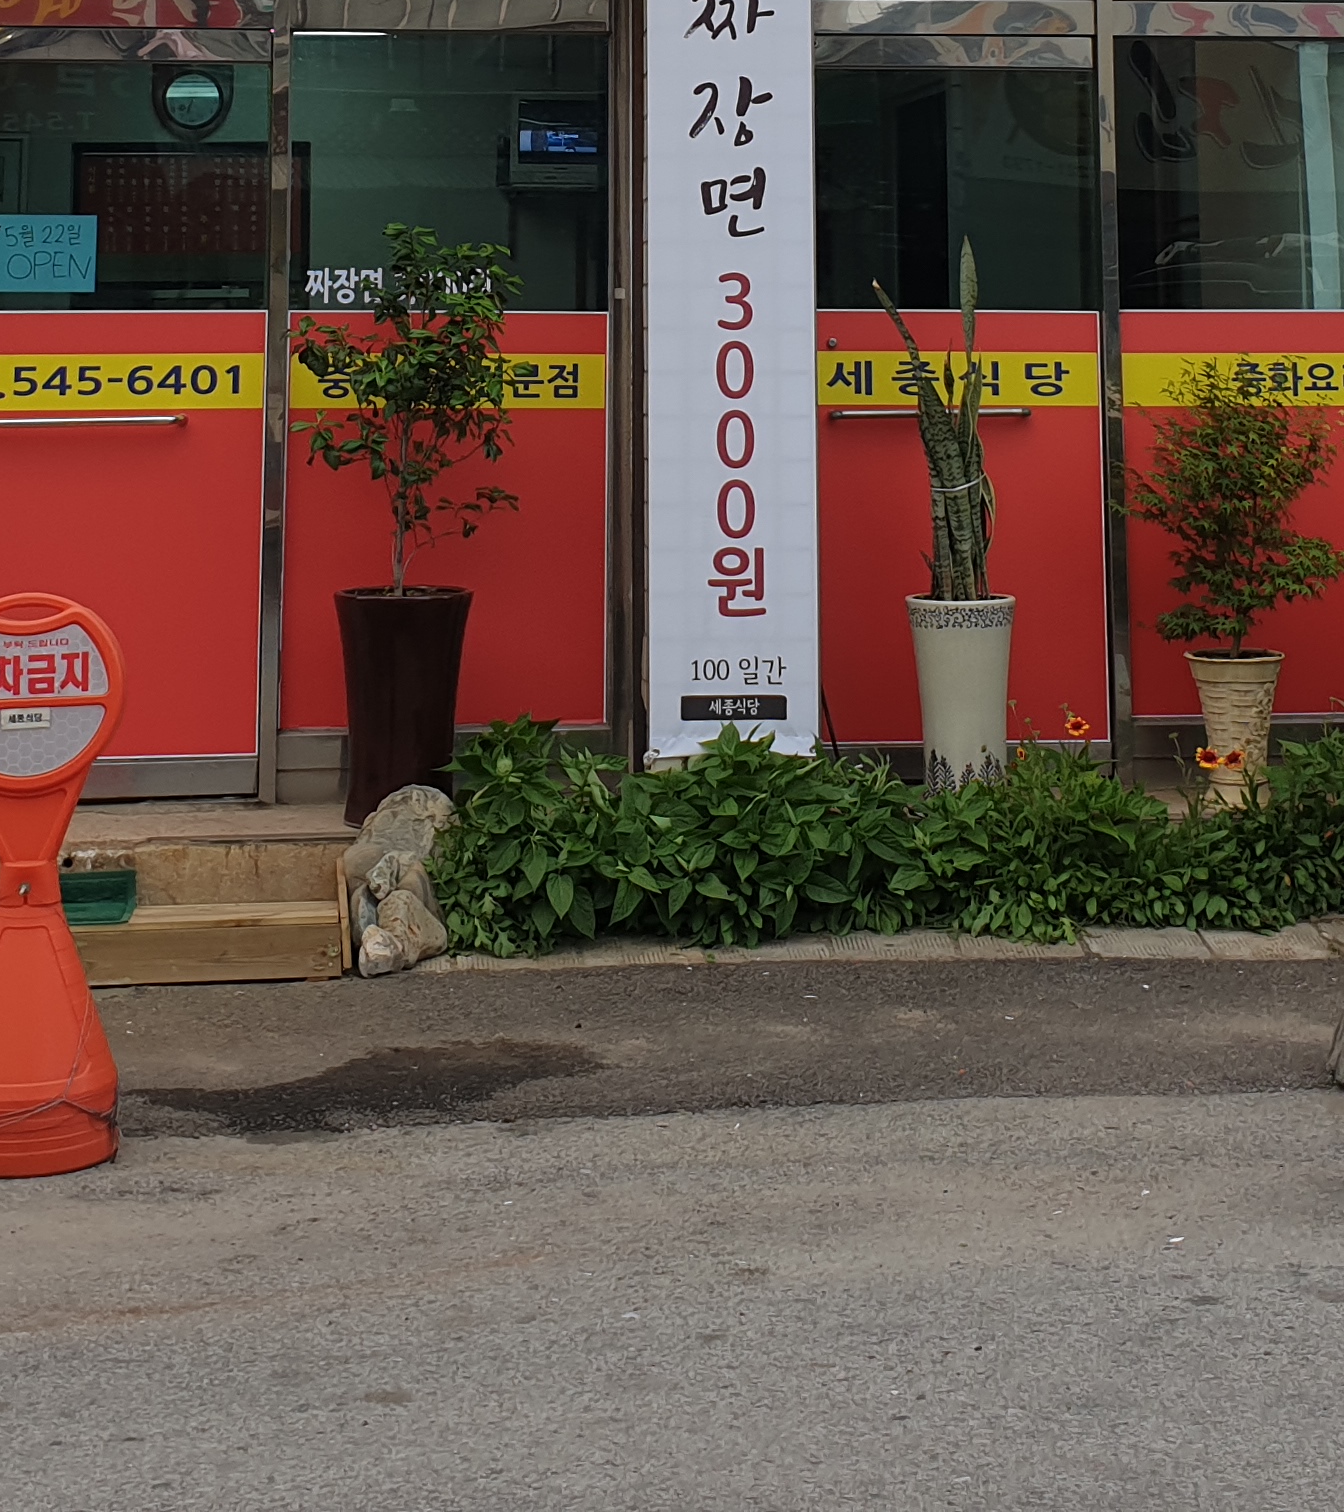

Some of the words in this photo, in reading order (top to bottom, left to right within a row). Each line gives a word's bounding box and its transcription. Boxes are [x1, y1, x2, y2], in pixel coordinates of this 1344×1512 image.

[5, 224, 34, 248] 5월
[42, 224, 81, 246] 22일
[7, 251, 92, 280] OPEN
[707, 271, 768, 618] 3000원
[690, 657, 730, 682] 100
[738, 656, 787, 686] 일간
[708, 696, 761, 716] 세종식당
